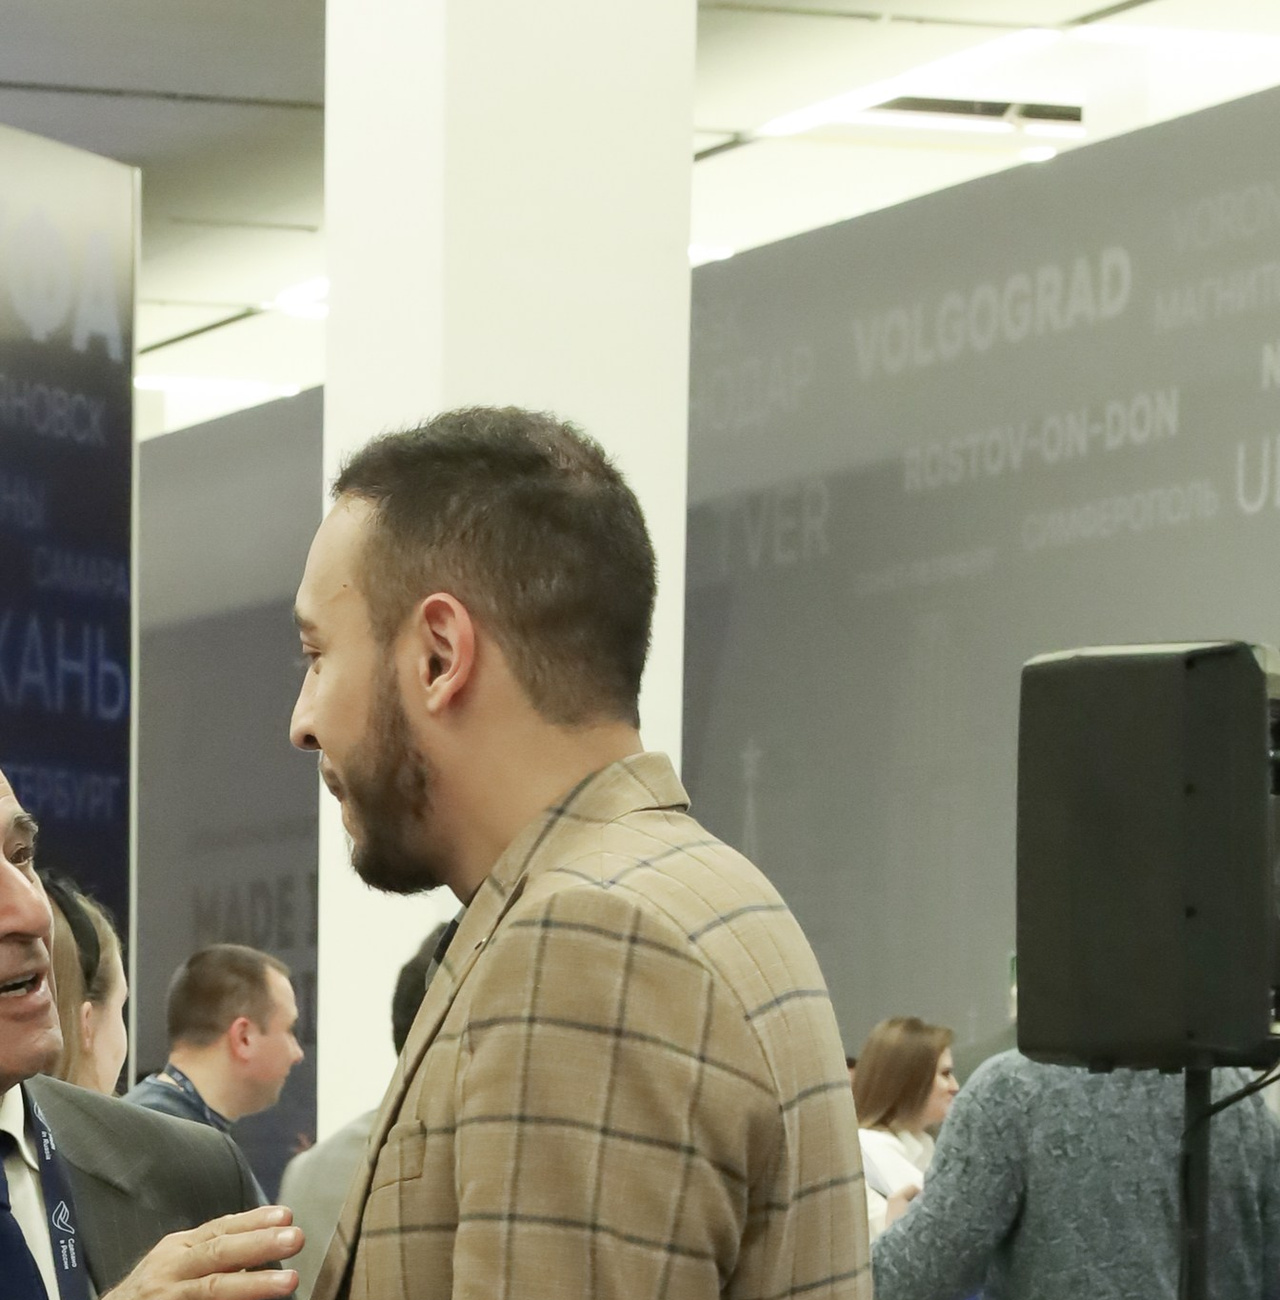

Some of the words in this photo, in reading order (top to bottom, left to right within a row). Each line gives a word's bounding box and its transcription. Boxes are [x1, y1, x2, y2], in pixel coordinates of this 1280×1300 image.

[849, 243, 1135, 384] VOLGOGRAD
[902, 384, 1183, 493] ROSTOV-ON-DON
[1235, 433, 1280, 515] U
